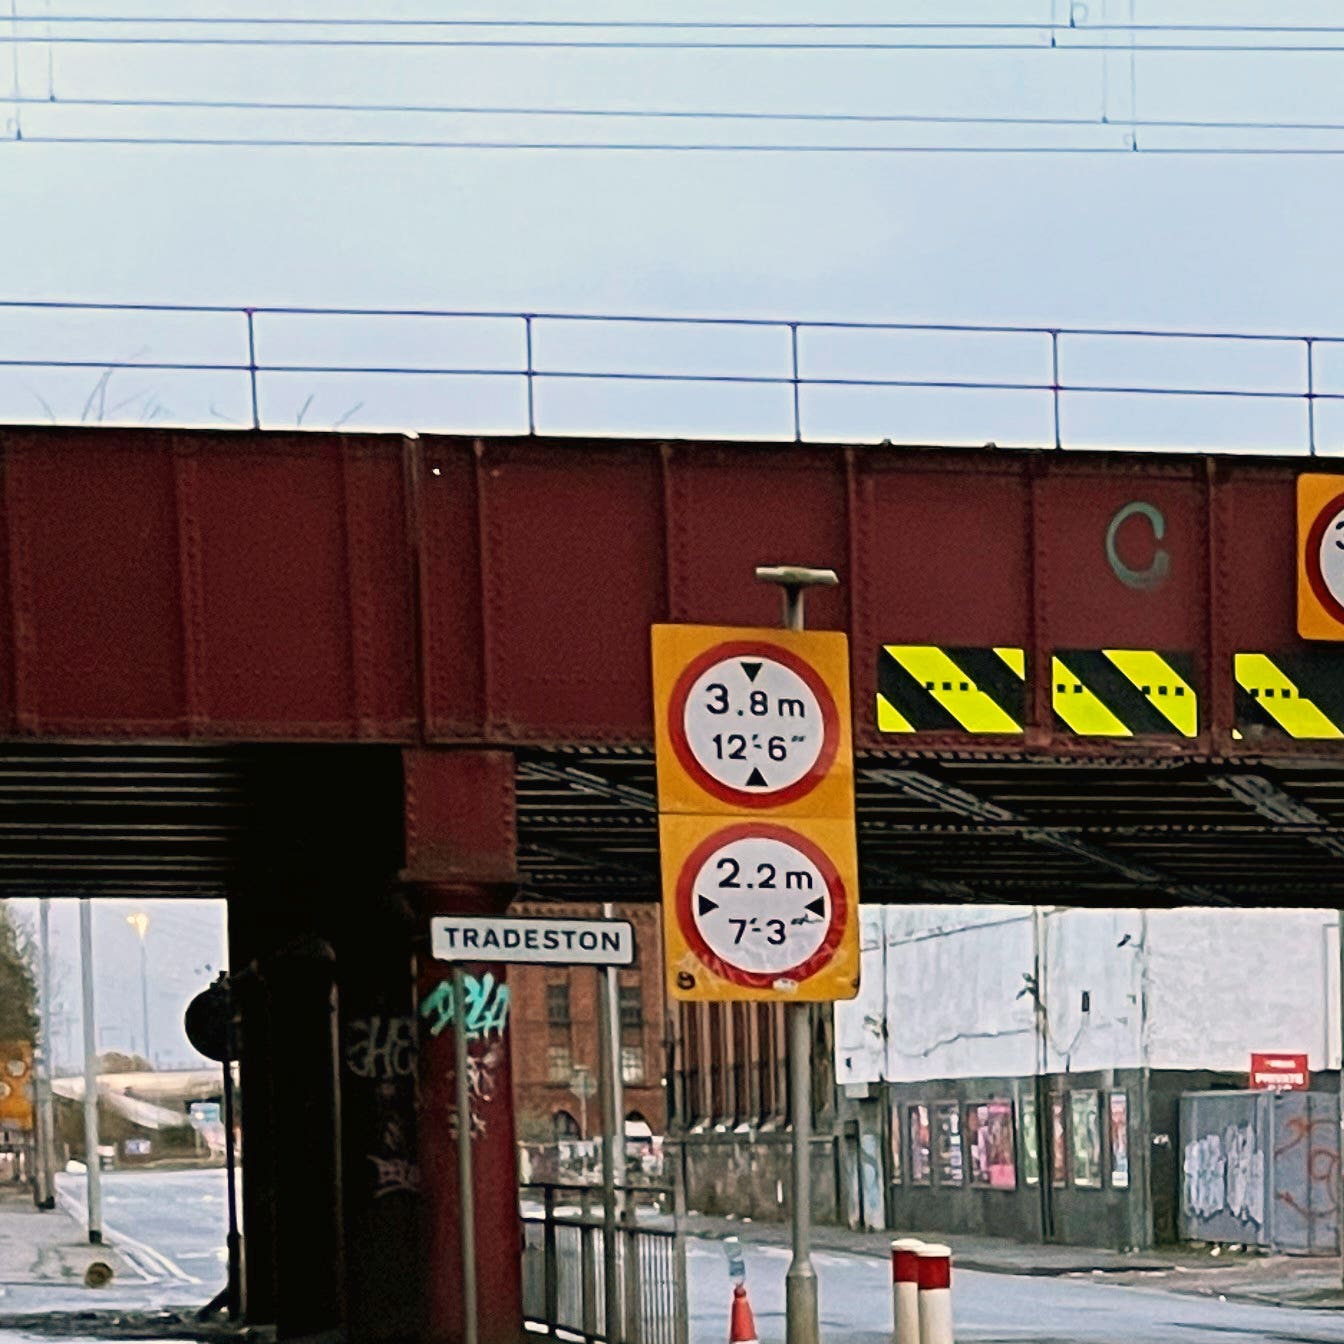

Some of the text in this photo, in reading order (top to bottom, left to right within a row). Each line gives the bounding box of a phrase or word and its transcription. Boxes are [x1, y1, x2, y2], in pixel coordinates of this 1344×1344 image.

[705, 683, 805, 718] 3.8 m
[716, 857, 813, 889] 2.2 m
[444, 927, 621, 952] TRADESTON
